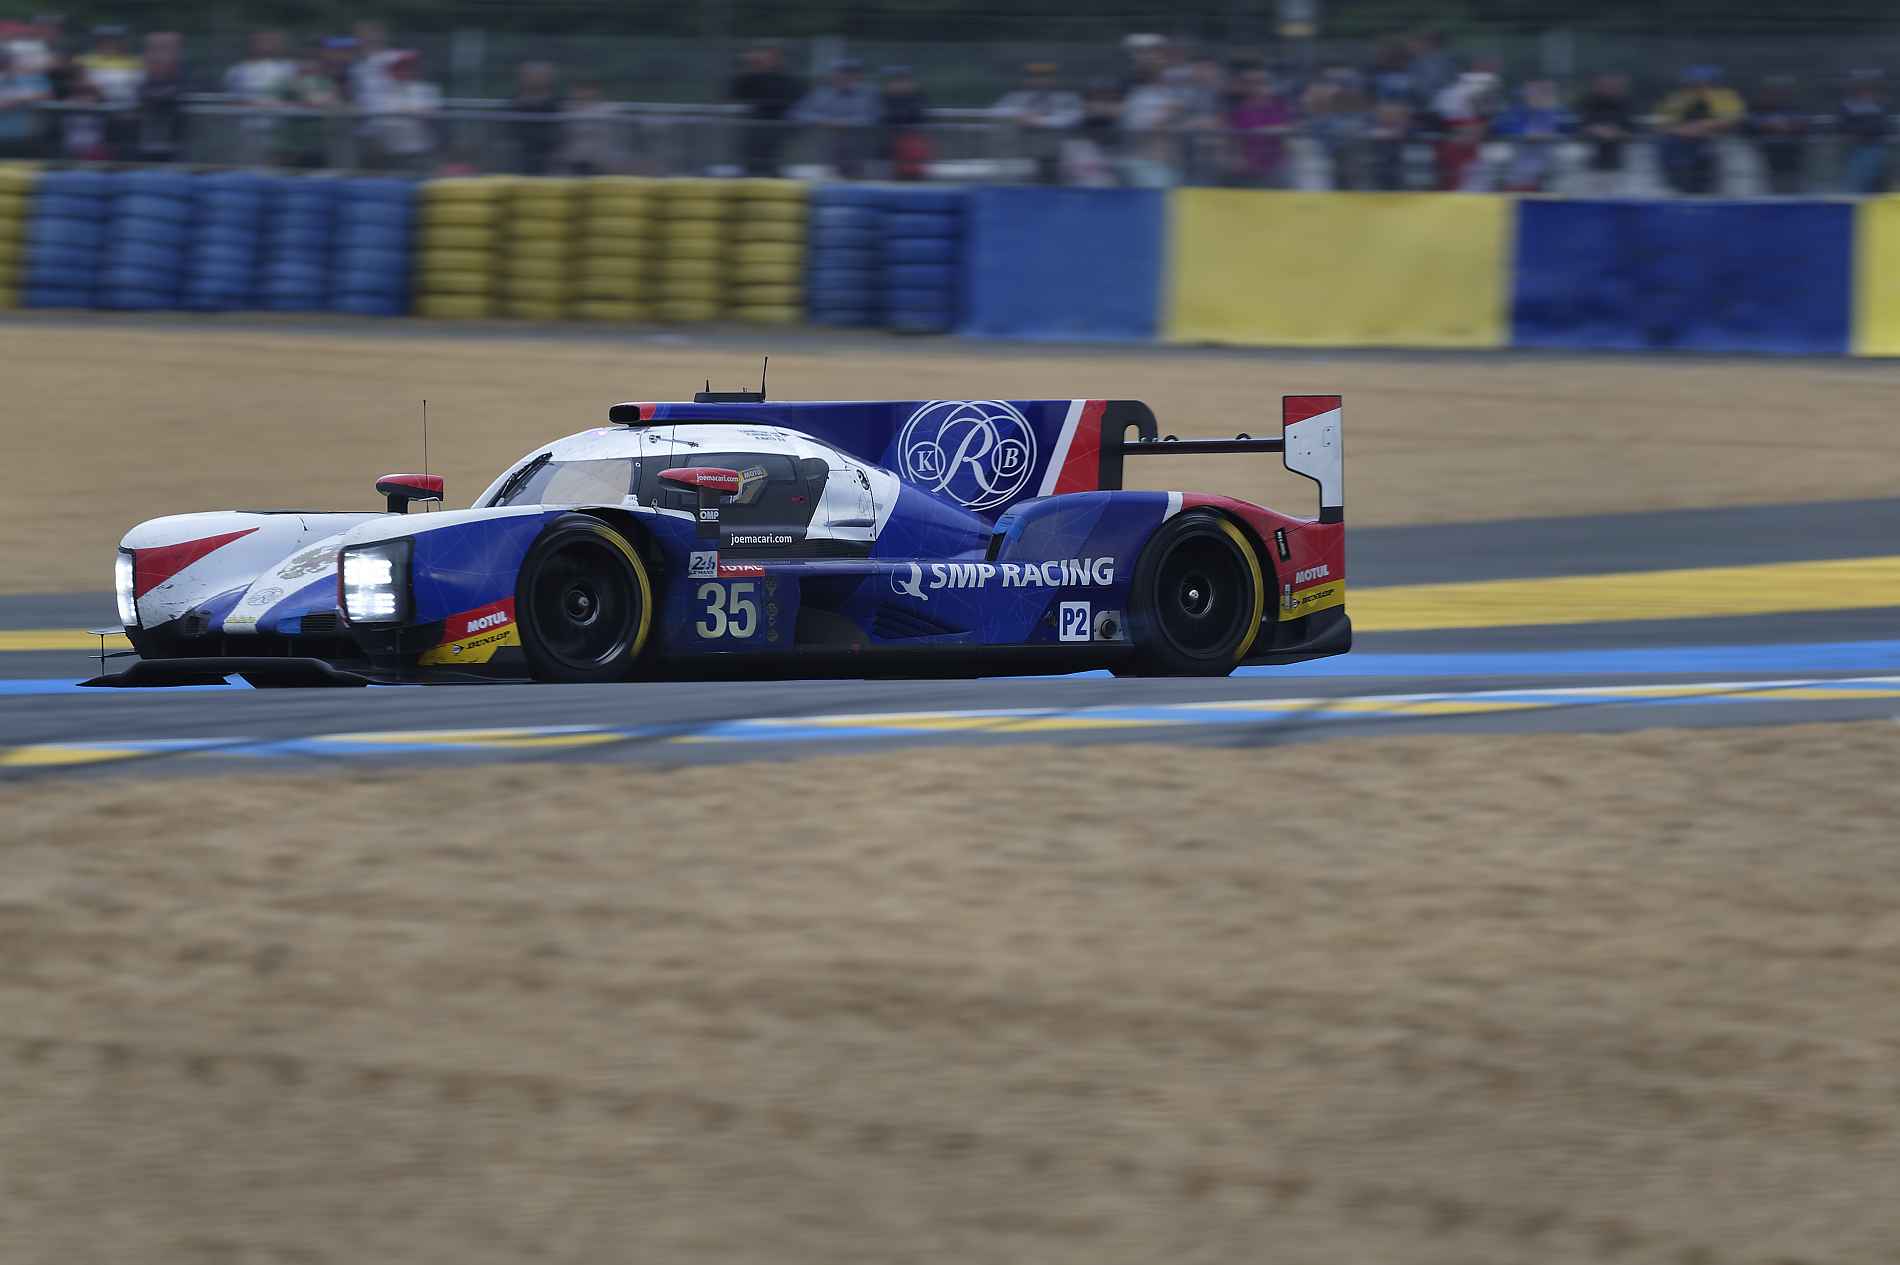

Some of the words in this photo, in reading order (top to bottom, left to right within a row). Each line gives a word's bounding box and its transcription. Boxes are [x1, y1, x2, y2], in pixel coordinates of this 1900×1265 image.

[917, 450, 936, 472] K
[1002, 448, 1019, 468] B
[700, 510, 720, 520] OMP
[730, 533, 792, 546] joemacari.com
[929, 563, 996, 589] SMP
[1000, 557, 1115, 588] RACING
[1295, 564, 1330, 584] MOTUL
[696, 582, 757, 639] 35
[1062, 607, 1087, 636] P2
[467, 611, 508, 633] MOTUL
[466, 631, 511, 649] DUNLOP
